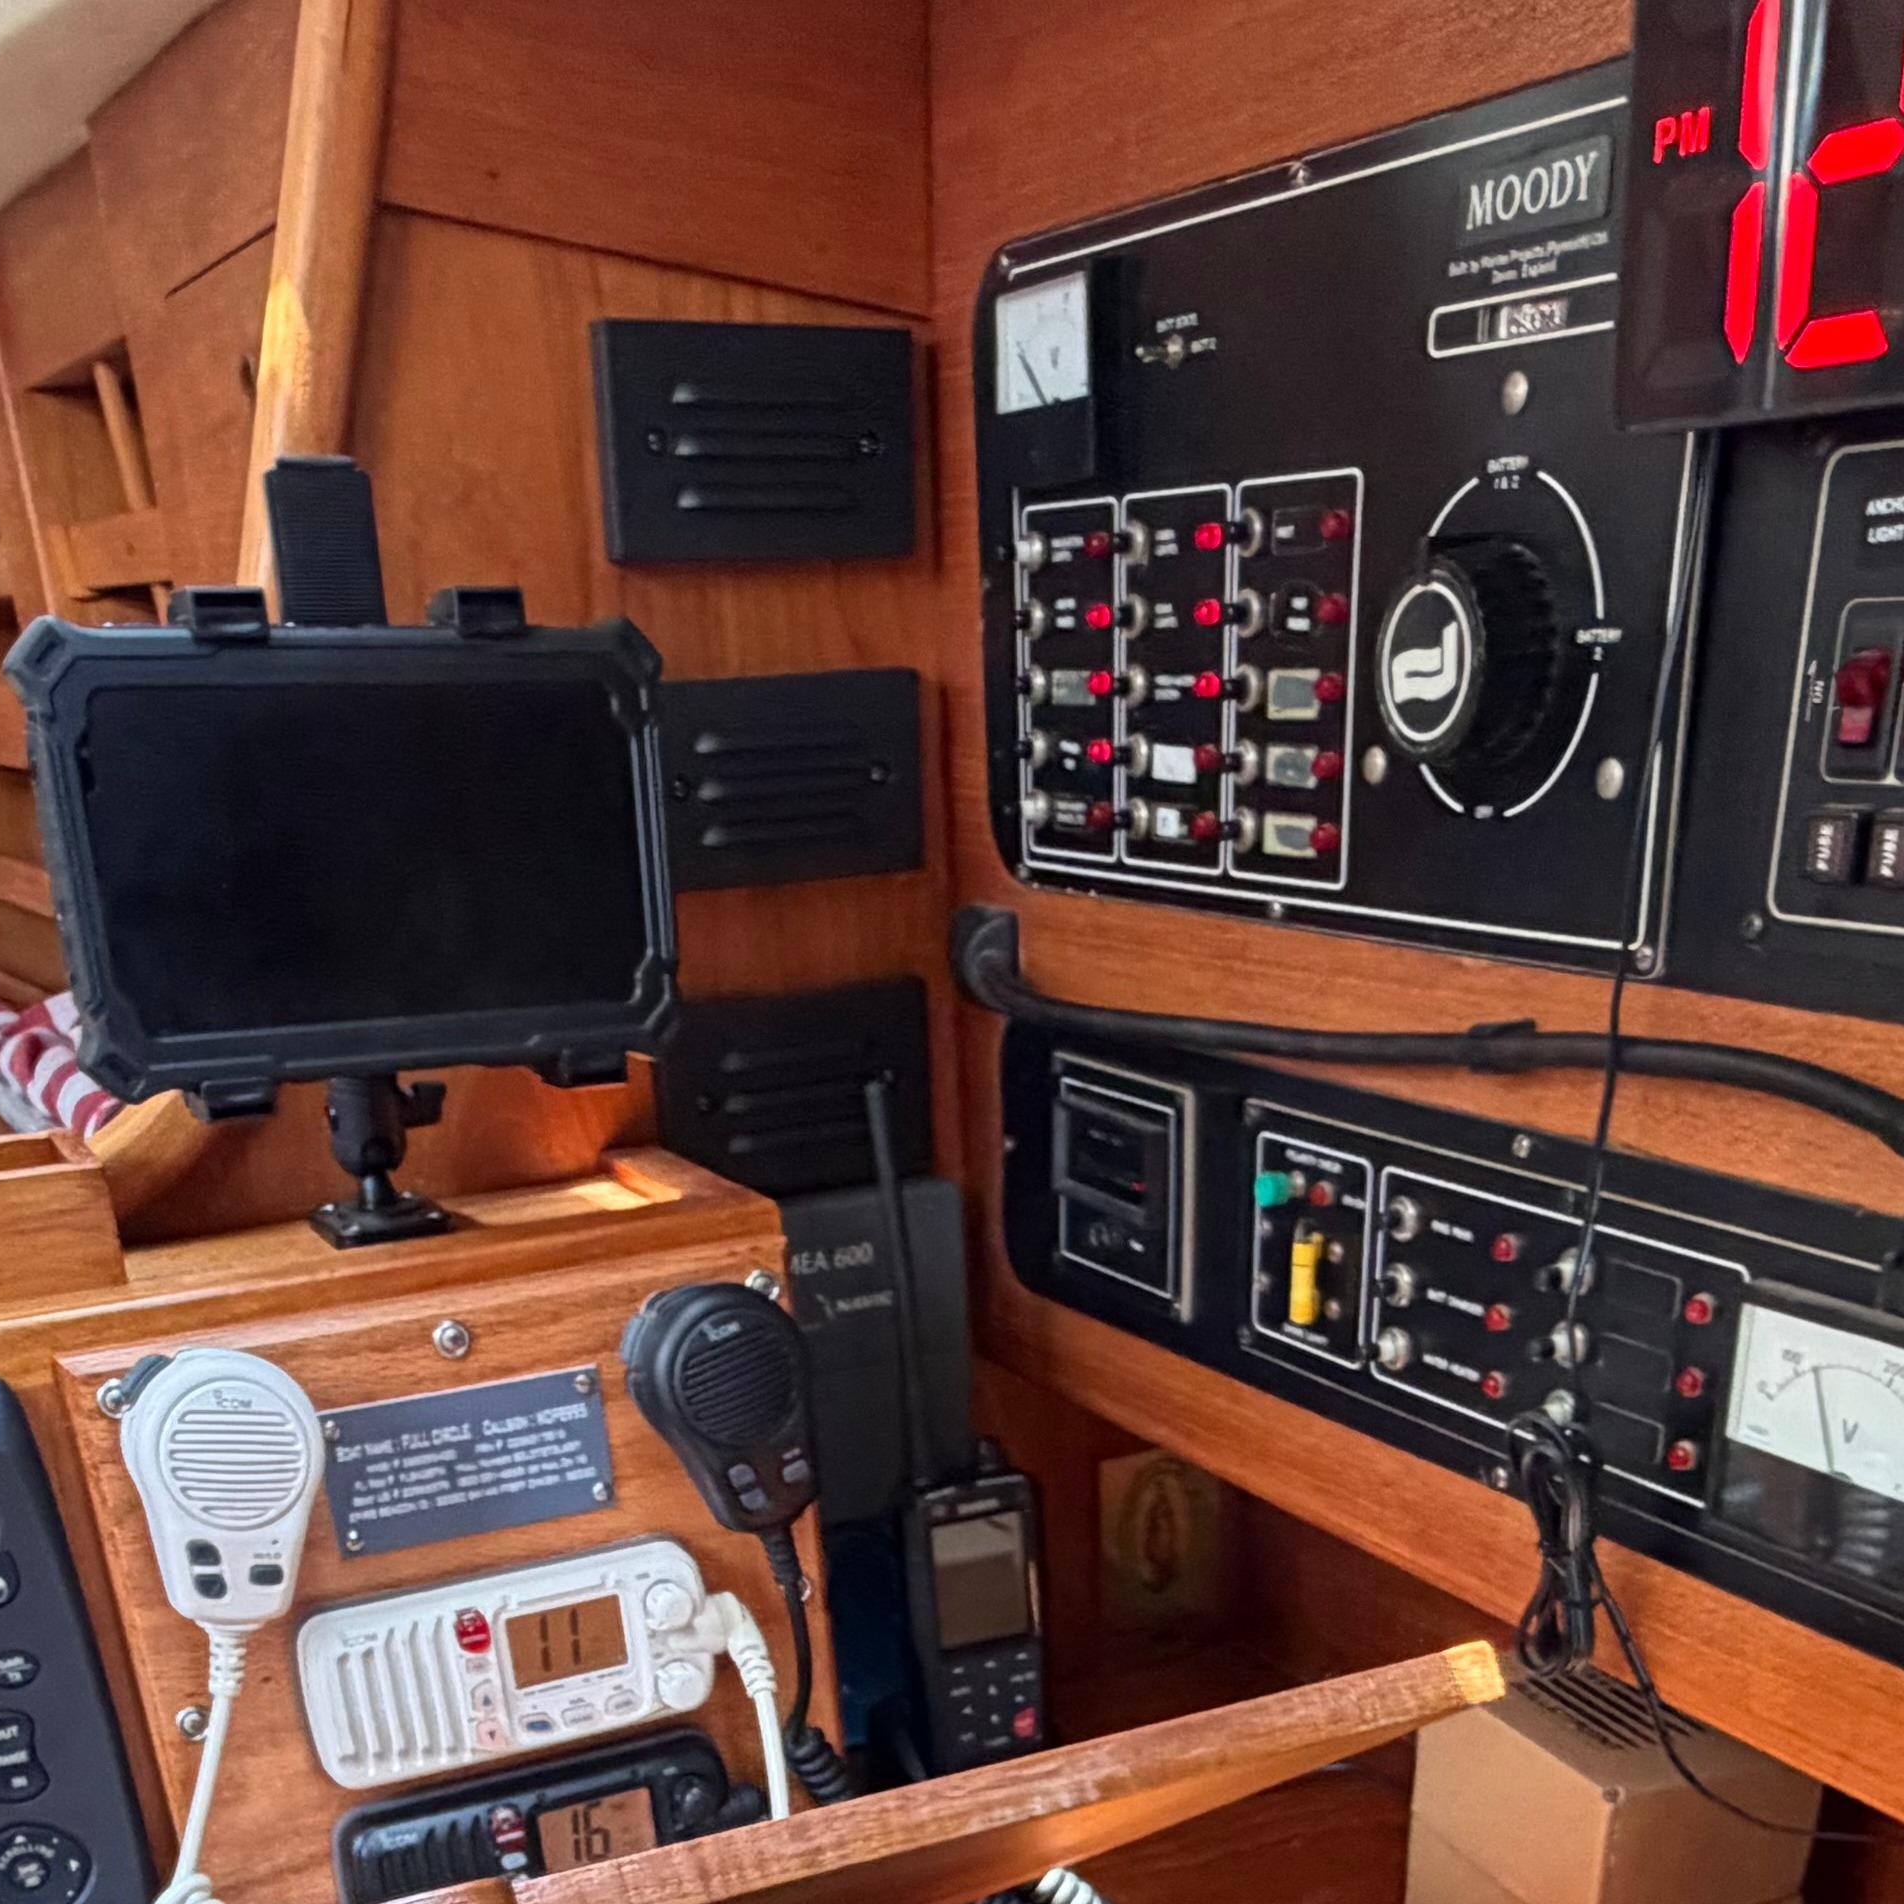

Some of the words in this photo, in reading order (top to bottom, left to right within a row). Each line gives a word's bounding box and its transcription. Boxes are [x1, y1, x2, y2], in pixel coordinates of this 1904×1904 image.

[1653, 107, 1713, 164] PM
[1466, 151, 1600, 230] MOODY
[1816, 824, 1834, 872] FUSE
[1880, 828, 1900, 878] FUSE
[1842, 1418, 1859, 1444] V
[539, 1606, 582, 1673] 11
